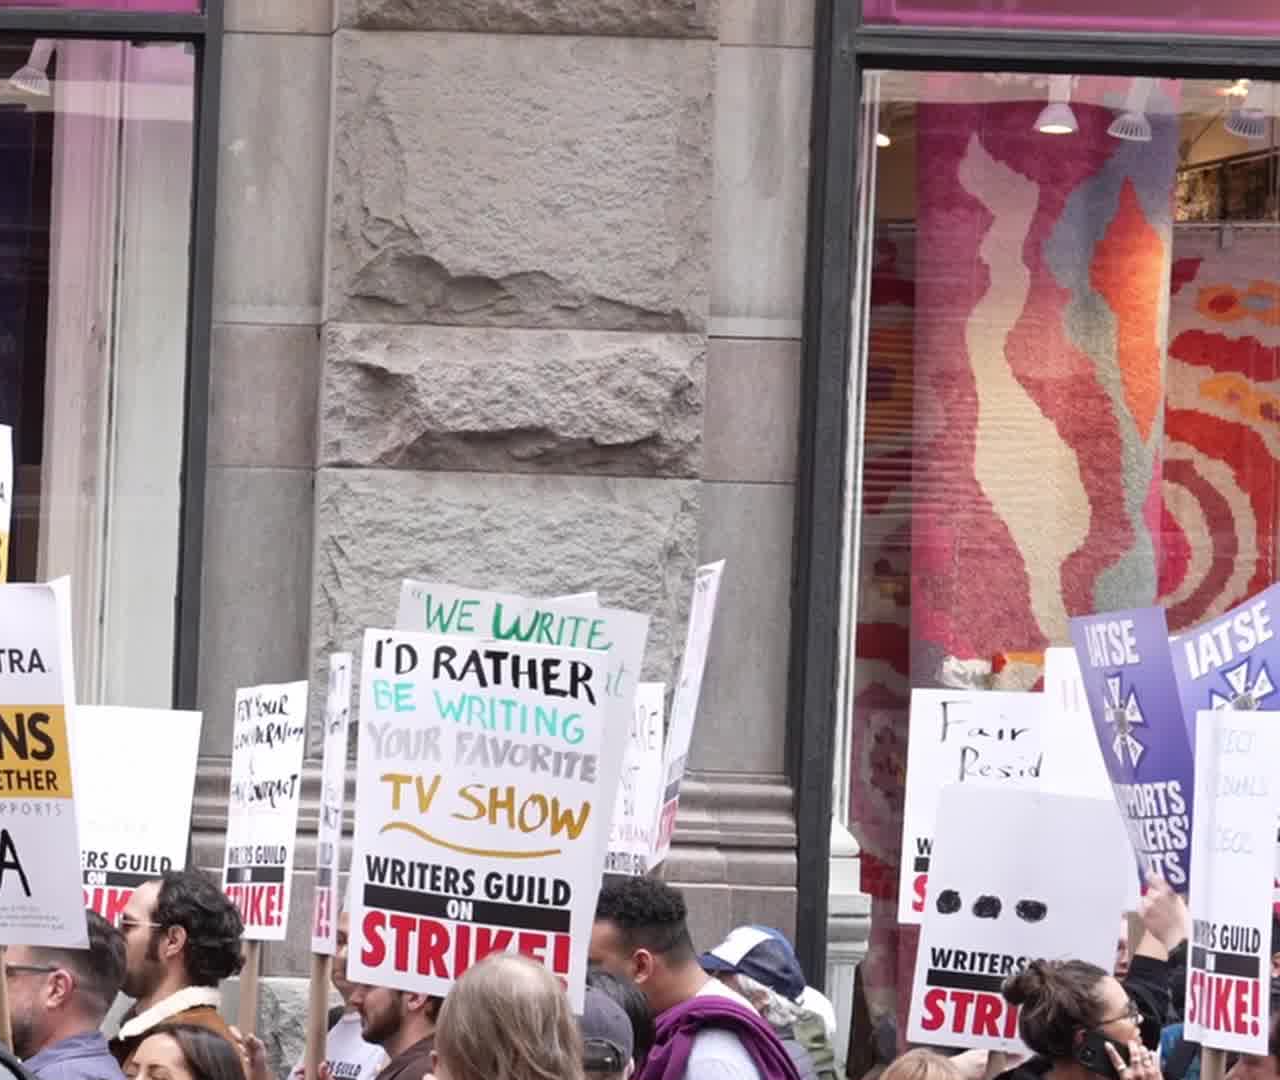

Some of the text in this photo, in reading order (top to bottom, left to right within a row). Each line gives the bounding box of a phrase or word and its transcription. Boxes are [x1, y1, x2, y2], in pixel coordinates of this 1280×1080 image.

[492, 603, 614, 651] WRITE
[1084, 619, 1142, 668] IATSE
[1185, 600, 1274, 681] IATSE
[374, 637, 596, 706] I'D RATHER
[372, 679, 586, 745] BE WRITING
[940, 700, 1032, 743] Fair
[367, 721, 600, 784] YOUR FAVORITE
[379, 773, 591, 841] TV SHOW
[115, 854, 173, 873] GUILD
[255, 846, 287, 865] GUILD
[366, 854, 572, 906] WRITERS GUILD
[446, 899, 474, 922] ON
[1220, 924, 1261, 954] GUILD
[921, 988, 1020, 1040] STRI
